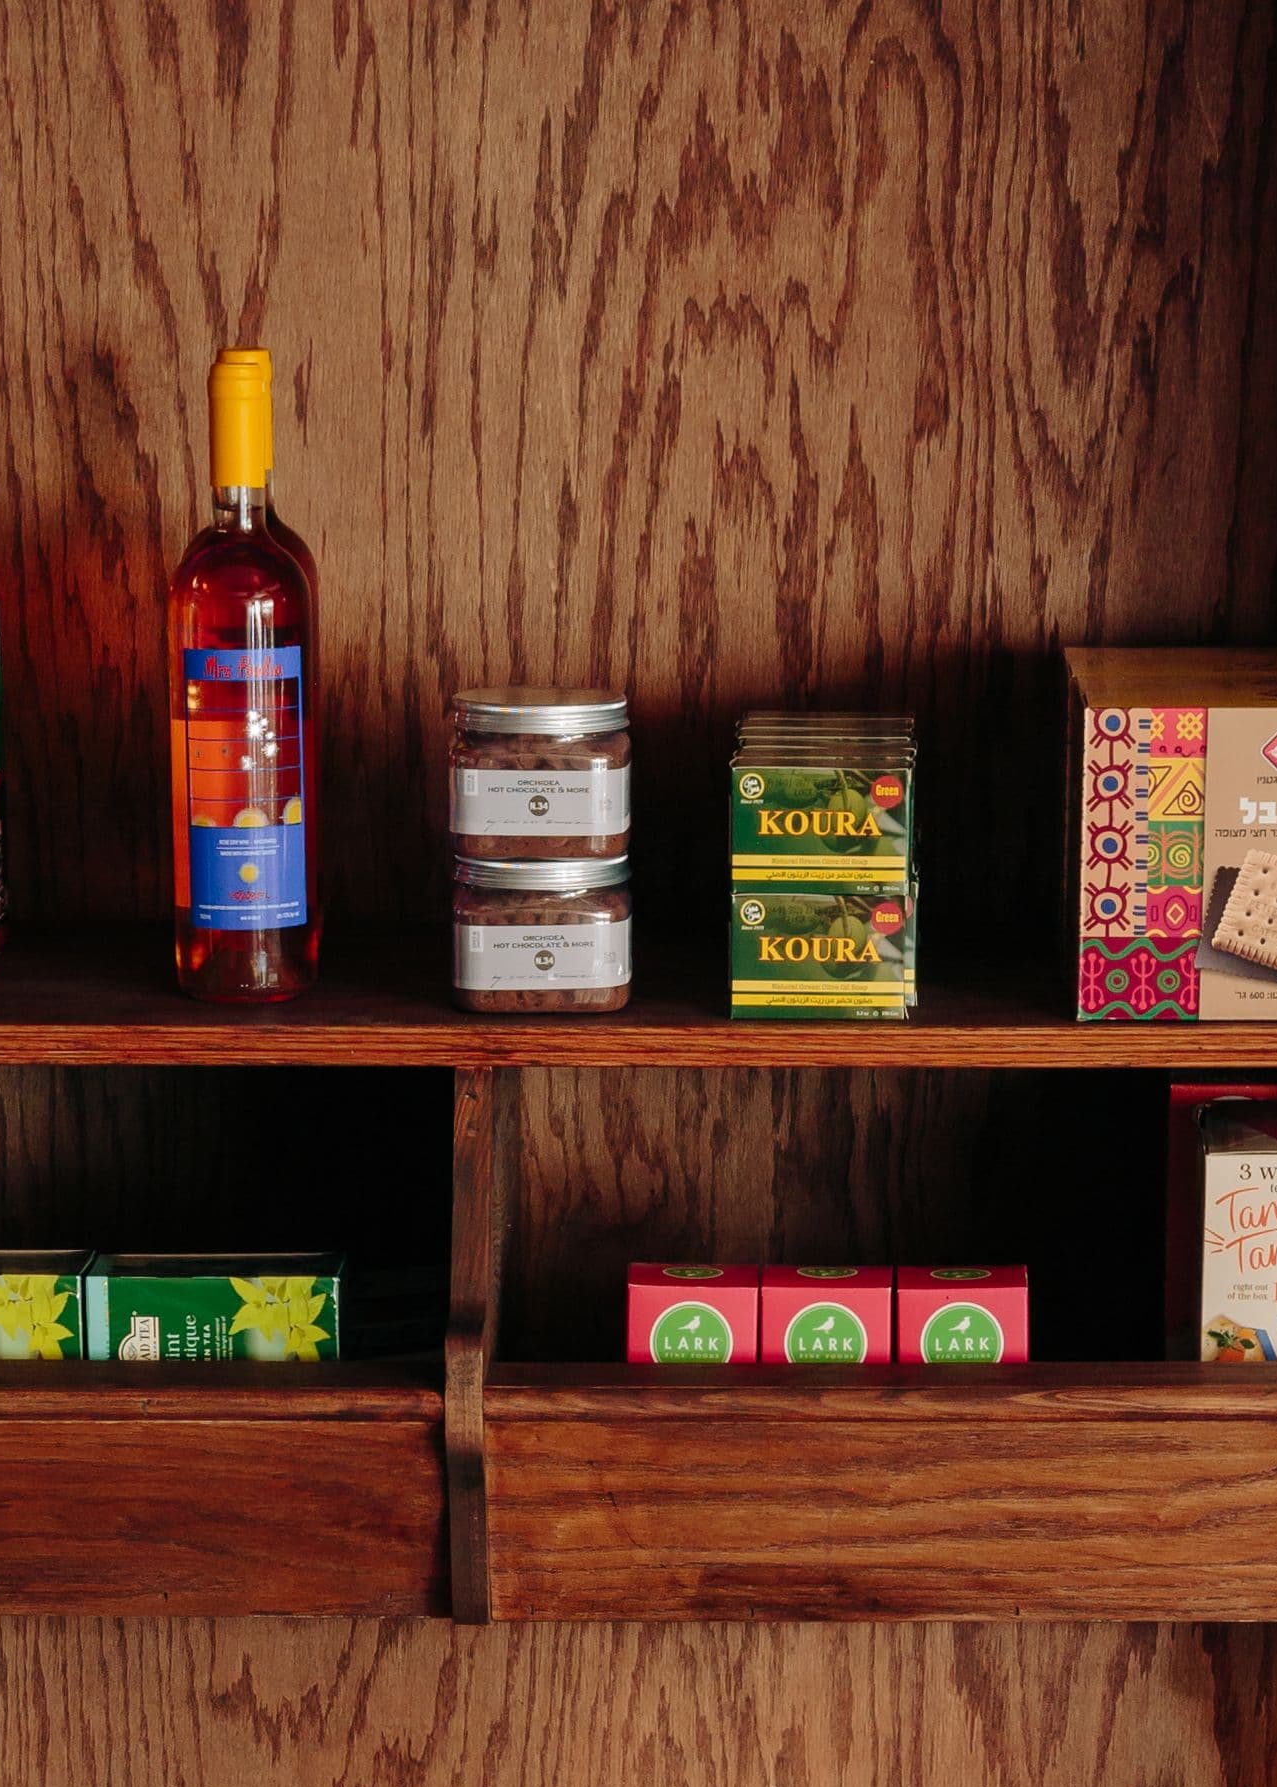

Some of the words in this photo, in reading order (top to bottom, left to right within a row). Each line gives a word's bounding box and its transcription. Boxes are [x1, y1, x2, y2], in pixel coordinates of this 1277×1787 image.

[875, 784, 899, 797] Green
[758, 809, 883, 837] KOURA
[1215, 829, 1247, 838] מצופה
[1249, 829, 1267, 838] חצי
[875, 911, 900, 923] Green
[758, 936, 883, 963] KOURA
[1249, 991, 1265, 1000] 600
[1239, 1163, 1252, 1180] 3
[1232, 1283, 1253, 1293] right
[1227, 1291, 1239, 1300] of
[1239, 1291, 1254, 1300] the
[1254, 1291, 1268, 1300] box
[664, 1336, 718, 1351] LARK
[798, 1336, 853, 1351] LARK
[934, 1336, 990, 1351] LARK
